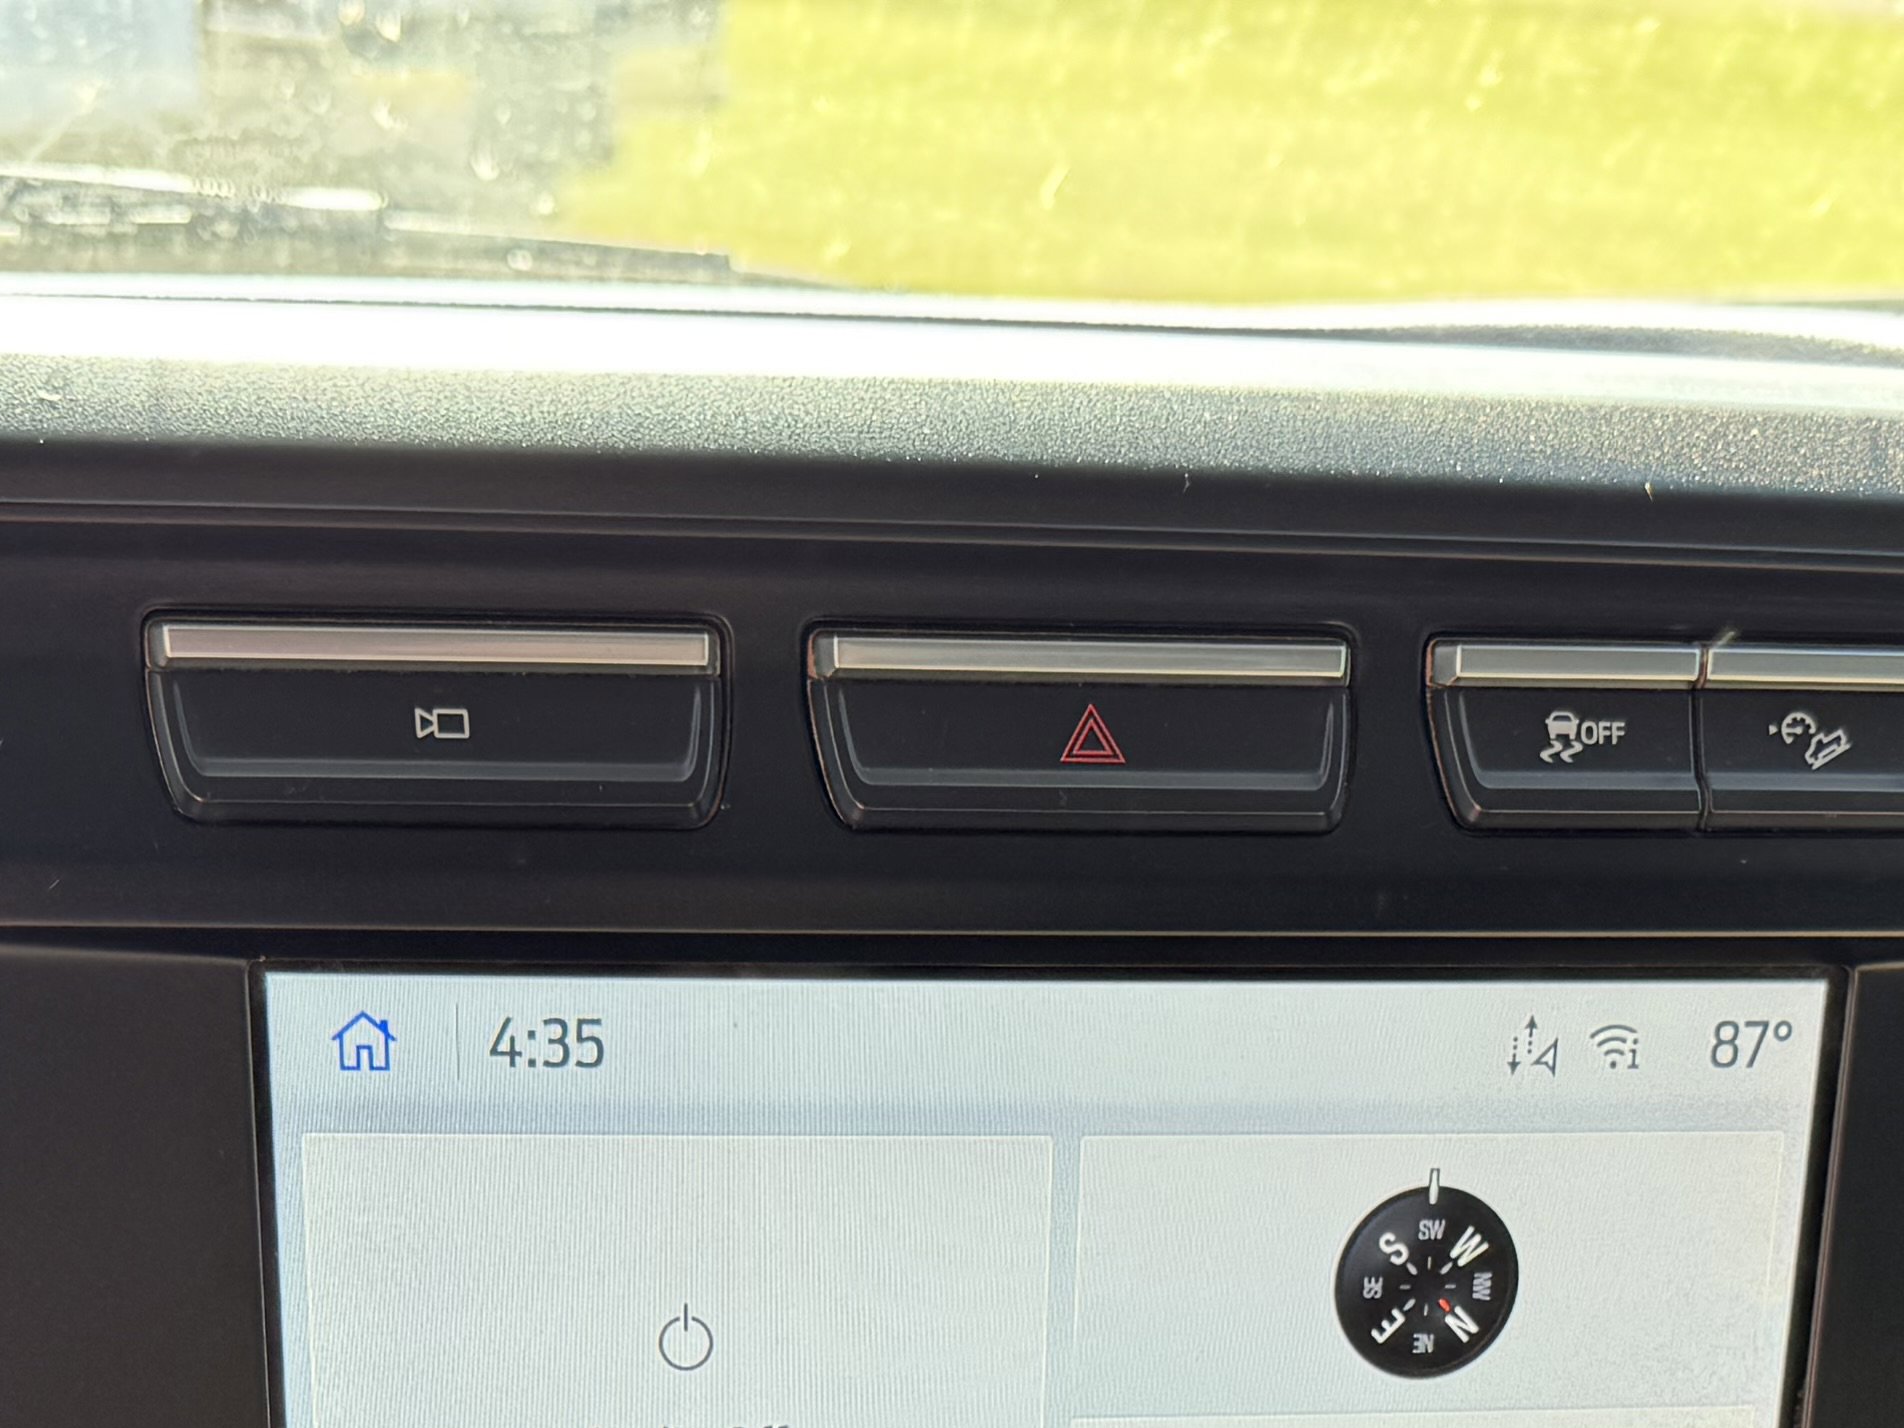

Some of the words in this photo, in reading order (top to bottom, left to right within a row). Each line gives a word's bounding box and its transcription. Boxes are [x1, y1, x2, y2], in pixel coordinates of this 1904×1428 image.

[1581, 720, 1625, 745] OFF
[488, 1016, 606, 1069] 4:35
[1709, 1020, 1794, 1070] 87°
[1418, 1219, 1445, 1240] SW
[1449, 1225, 1489, 1267] W
[1379, 1231, 1409, 1266] S
[1362, 1276, 1384, 1299] SE
[1471, 1271, 1493, 1301] NW
[1371, 1308, 1406, 1345] E
[1445, 1305, 1480, 1344] N
[1412, 1333, 1435, 1354] NE
